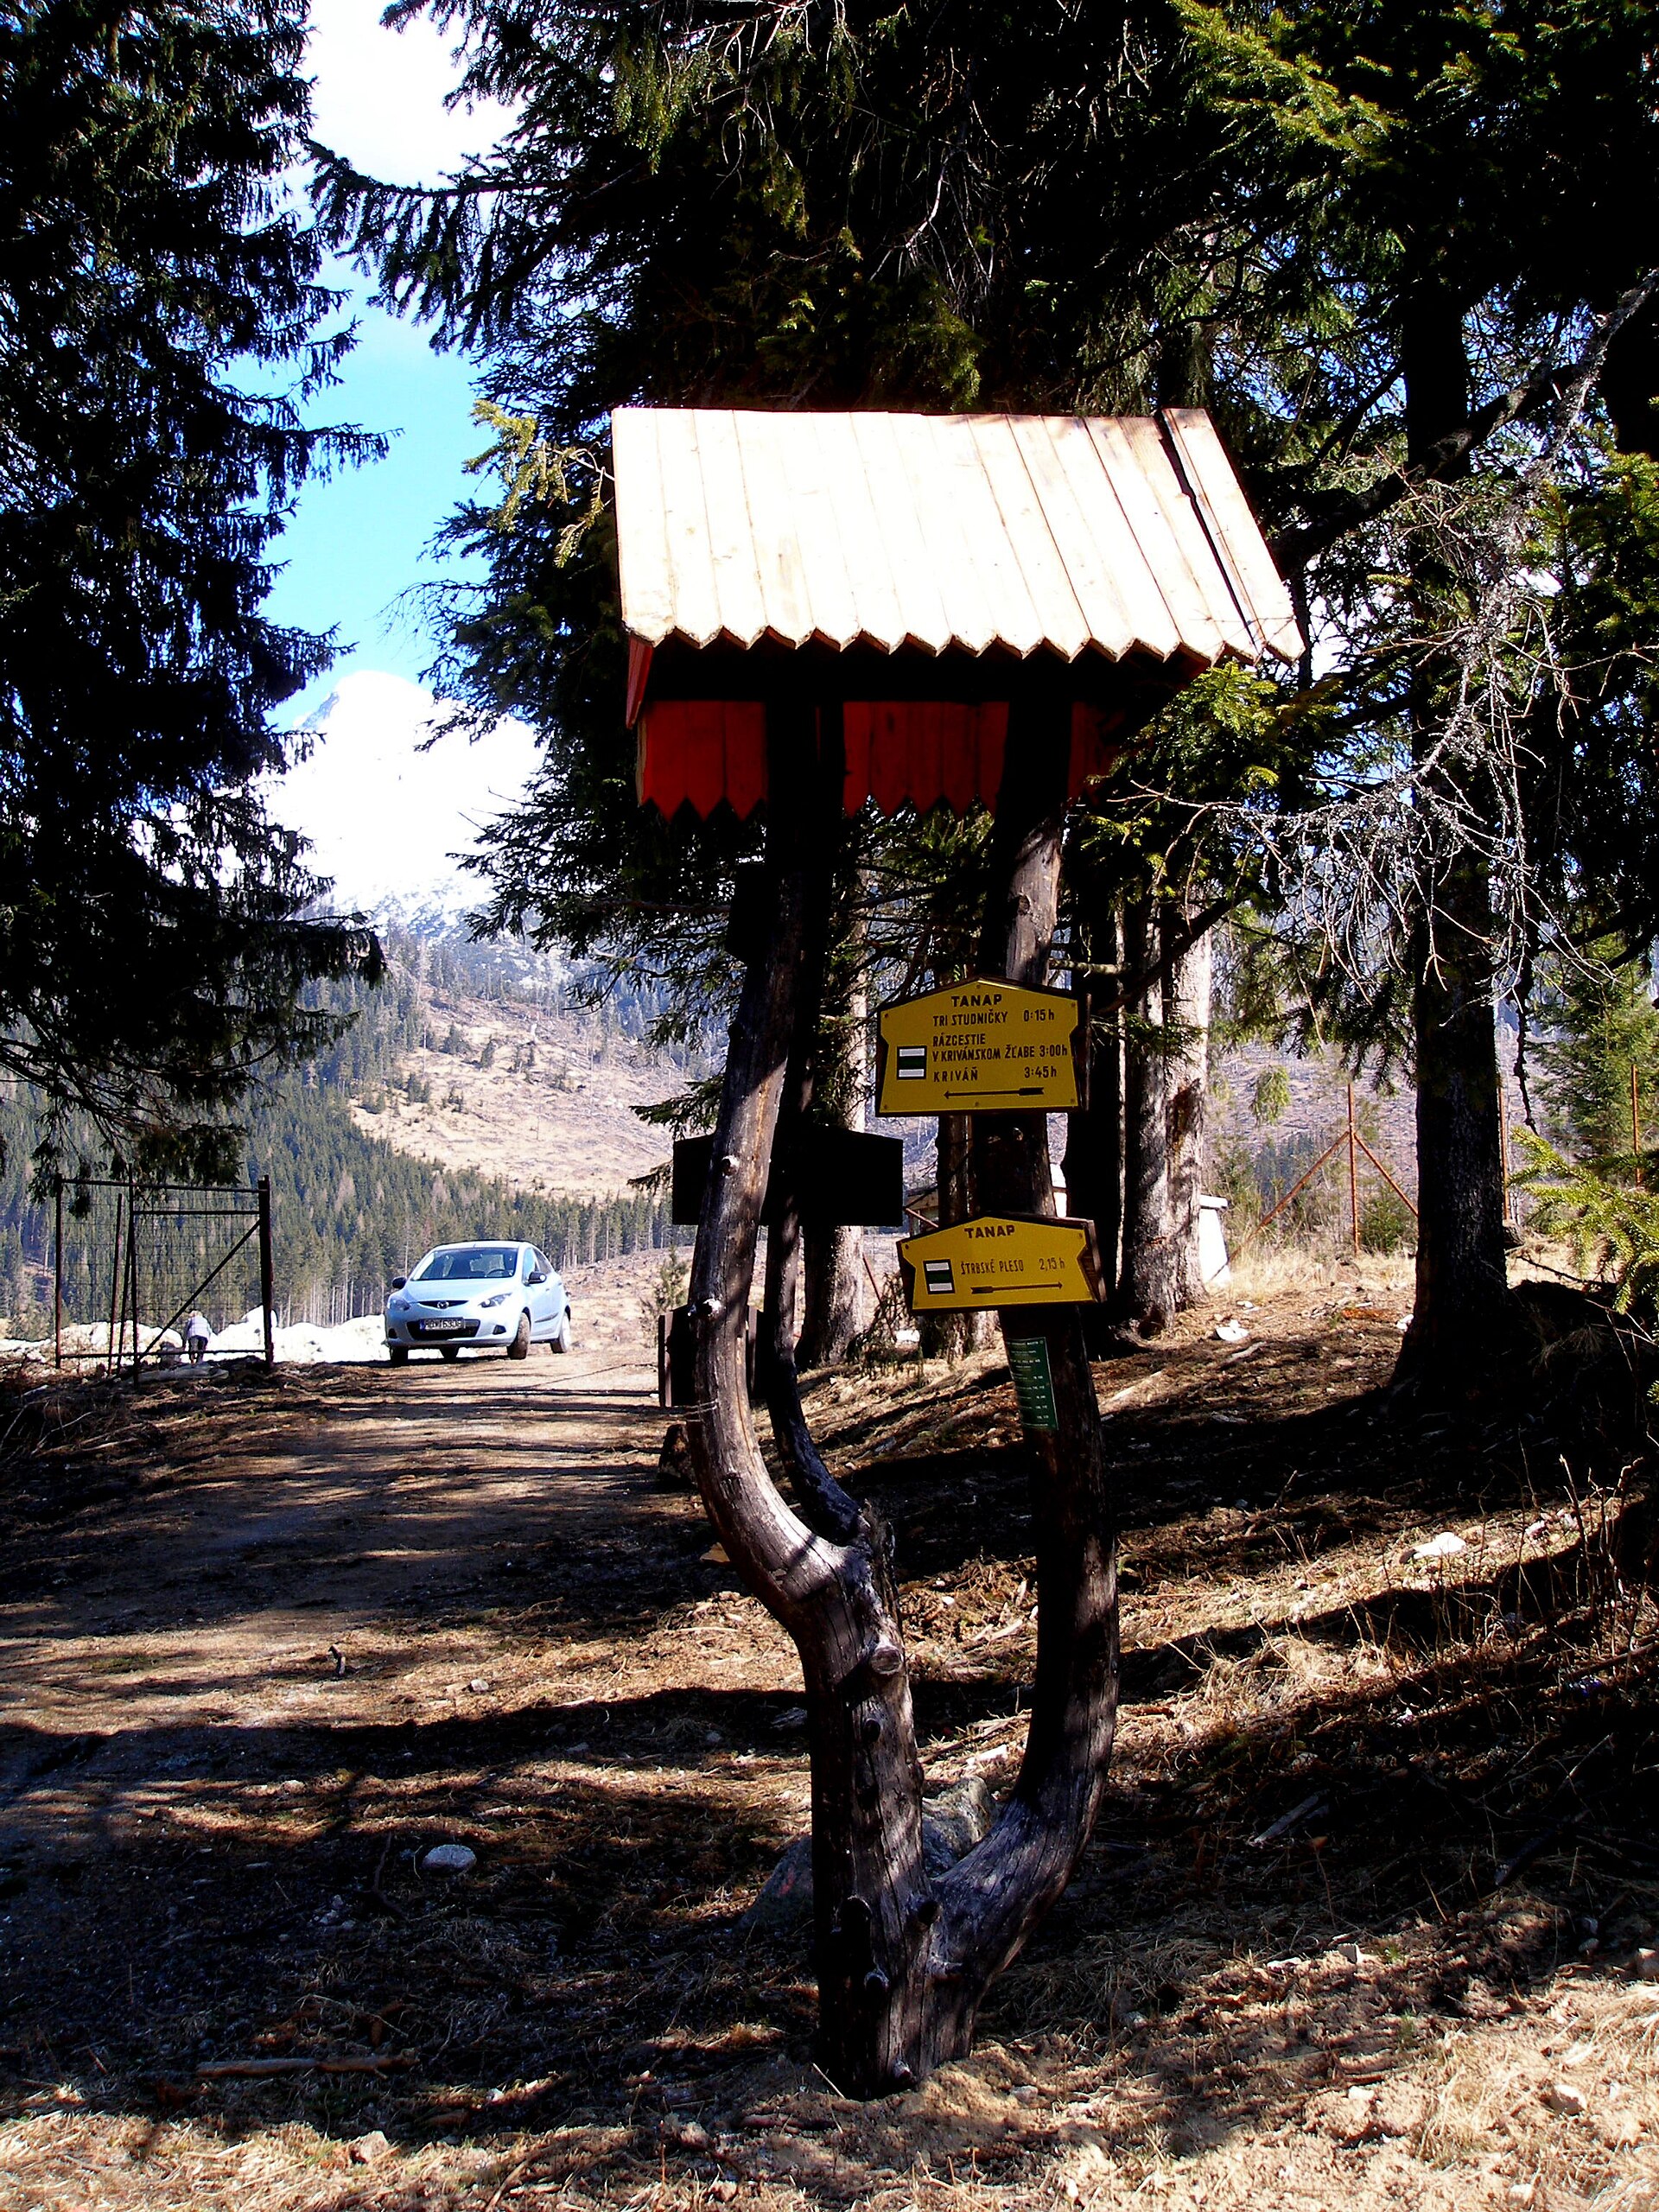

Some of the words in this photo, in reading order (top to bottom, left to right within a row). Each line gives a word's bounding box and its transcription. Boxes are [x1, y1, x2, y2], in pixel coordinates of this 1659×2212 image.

[950, 994, 1002, 1007] TANAP
[932, 1014, 948, 1027] TRI
[951, 1008, 1008, 1026] STUDNIČKY
[932, 1032, 986, 1047] RÁZCESTIE
[932, 1051, 939, 1062] V
[941, 1046, 1001, 1062] KRIVÁNSKOM
[1004, 1044, 1035, 1059] ŽĽABE
[933, 1066, 978, 1083] KRIVÁŇ
[963, 1224, 1015, 1239] TANAP
[961, 1258, 995, 1275] ŠTRBSKÉ
[999, 1259, 1024, 1273] PLESO
